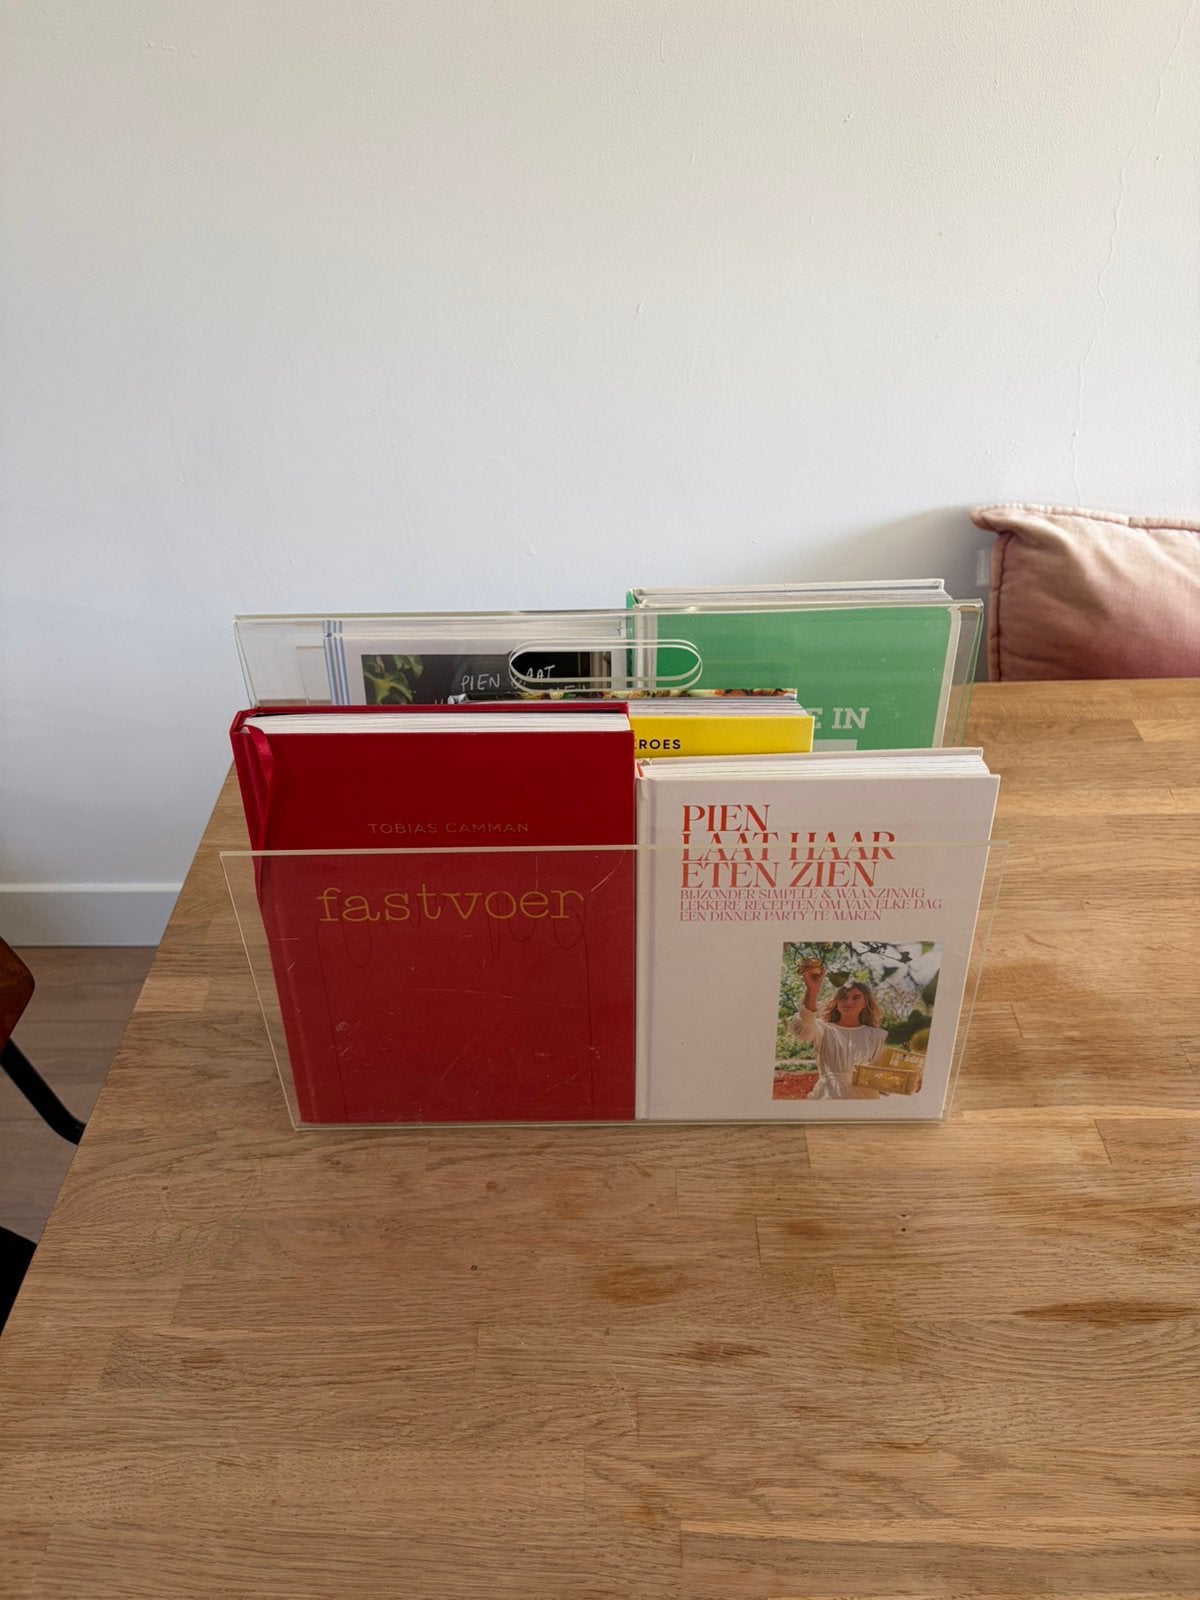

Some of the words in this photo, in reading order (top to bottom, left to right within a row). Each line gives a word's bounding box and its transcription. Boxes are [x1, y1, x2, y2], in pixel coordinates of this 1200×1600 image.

[461, 673, 500, 692] PIEN
[831, 707, 869, 729] IN
[635, 739, 681, 750] ROES
[681, 804, 770, 832] PIEN
[368, 823, 437, 834] TOBIAS
[445, 822, 529, 834] CAMMAN
[681, 832, 779, 861] LAAT
[789, 831, 895, 860] HAAR
[681, 861, 779, 888] ETEN
[789, 861, 878, 888] ZIEN
[316, 883, 585, 922] fastvoer
[680, 889, 755, 900] BIJZONDER
[758, 889, 818, 900] SIMPELE
[821, 888, 832, 899] &
[836, 887, 925, 899] WAANZINNIG
[680, 900, 741, 910] LEKKERE
[744, 900, 816, 910] RECEPTEN
[819, 899, 841, 910] OM
[845, 899, 874, 910] VAN
[876, 899, 911, 910] ELKE
[914, 899, 942, 910] DAG
[680, 910, 706, 921] EEN
[710, 910, 761, 921] DINNER
[764, 910, 808, 921] PARTY
[812, 910, 829, 921] TE
[833, 910, 882, 920] MAKEN
